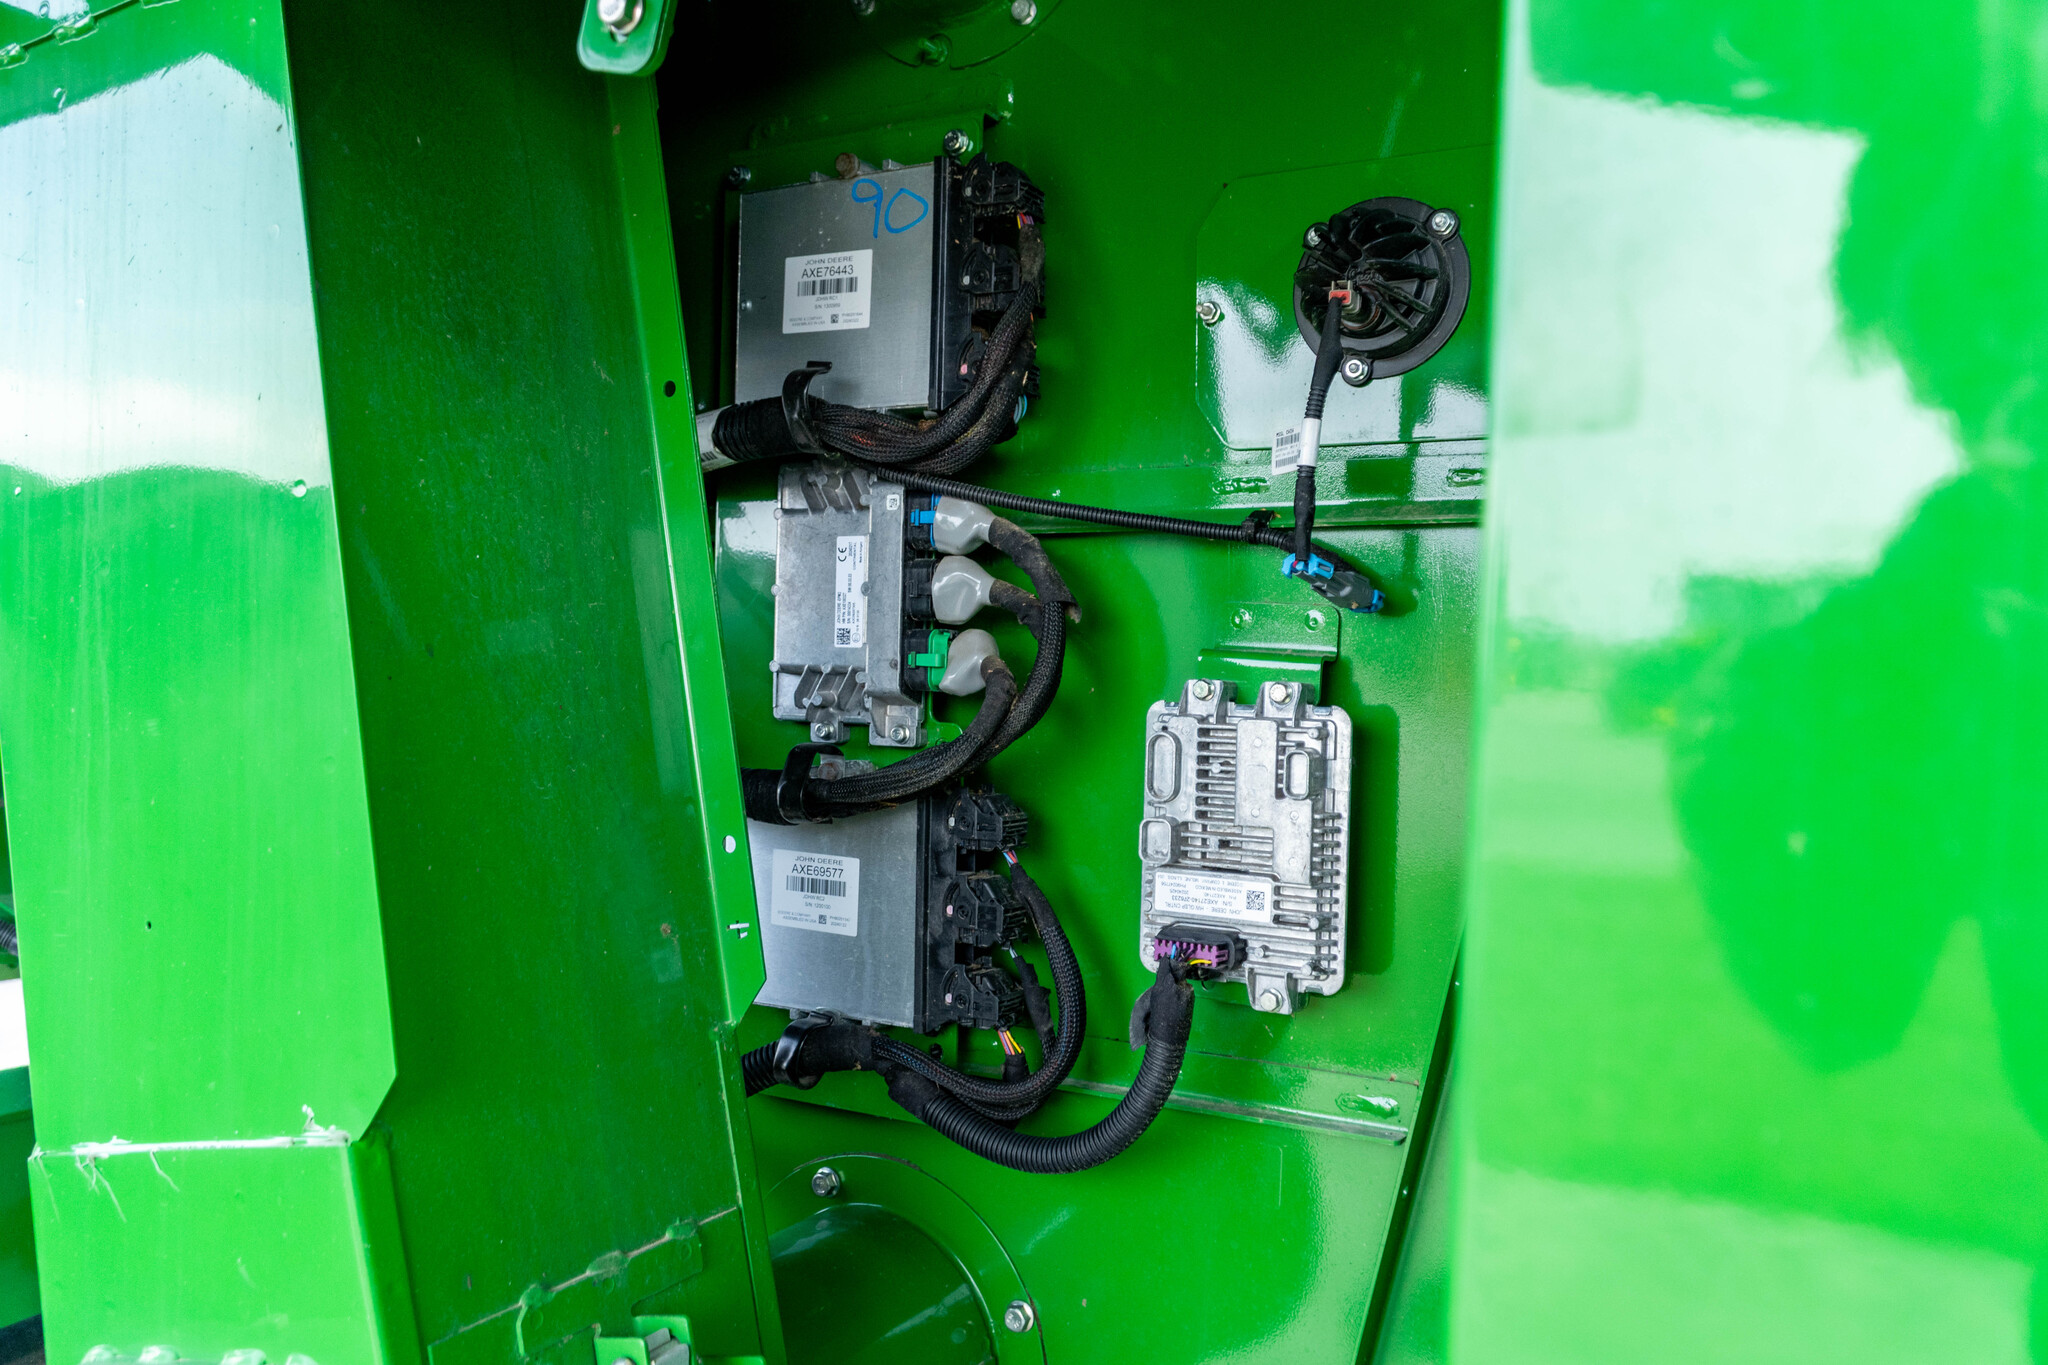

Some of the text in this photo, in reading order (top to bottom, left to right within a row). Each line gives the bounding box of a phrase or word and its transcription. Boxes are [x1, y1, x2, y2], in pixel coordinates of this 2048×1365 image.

[852, 178, 928, 238] 90
[802, 264, 854, 279] AXE76443
[792, 864, 844, 878] AXE69577
